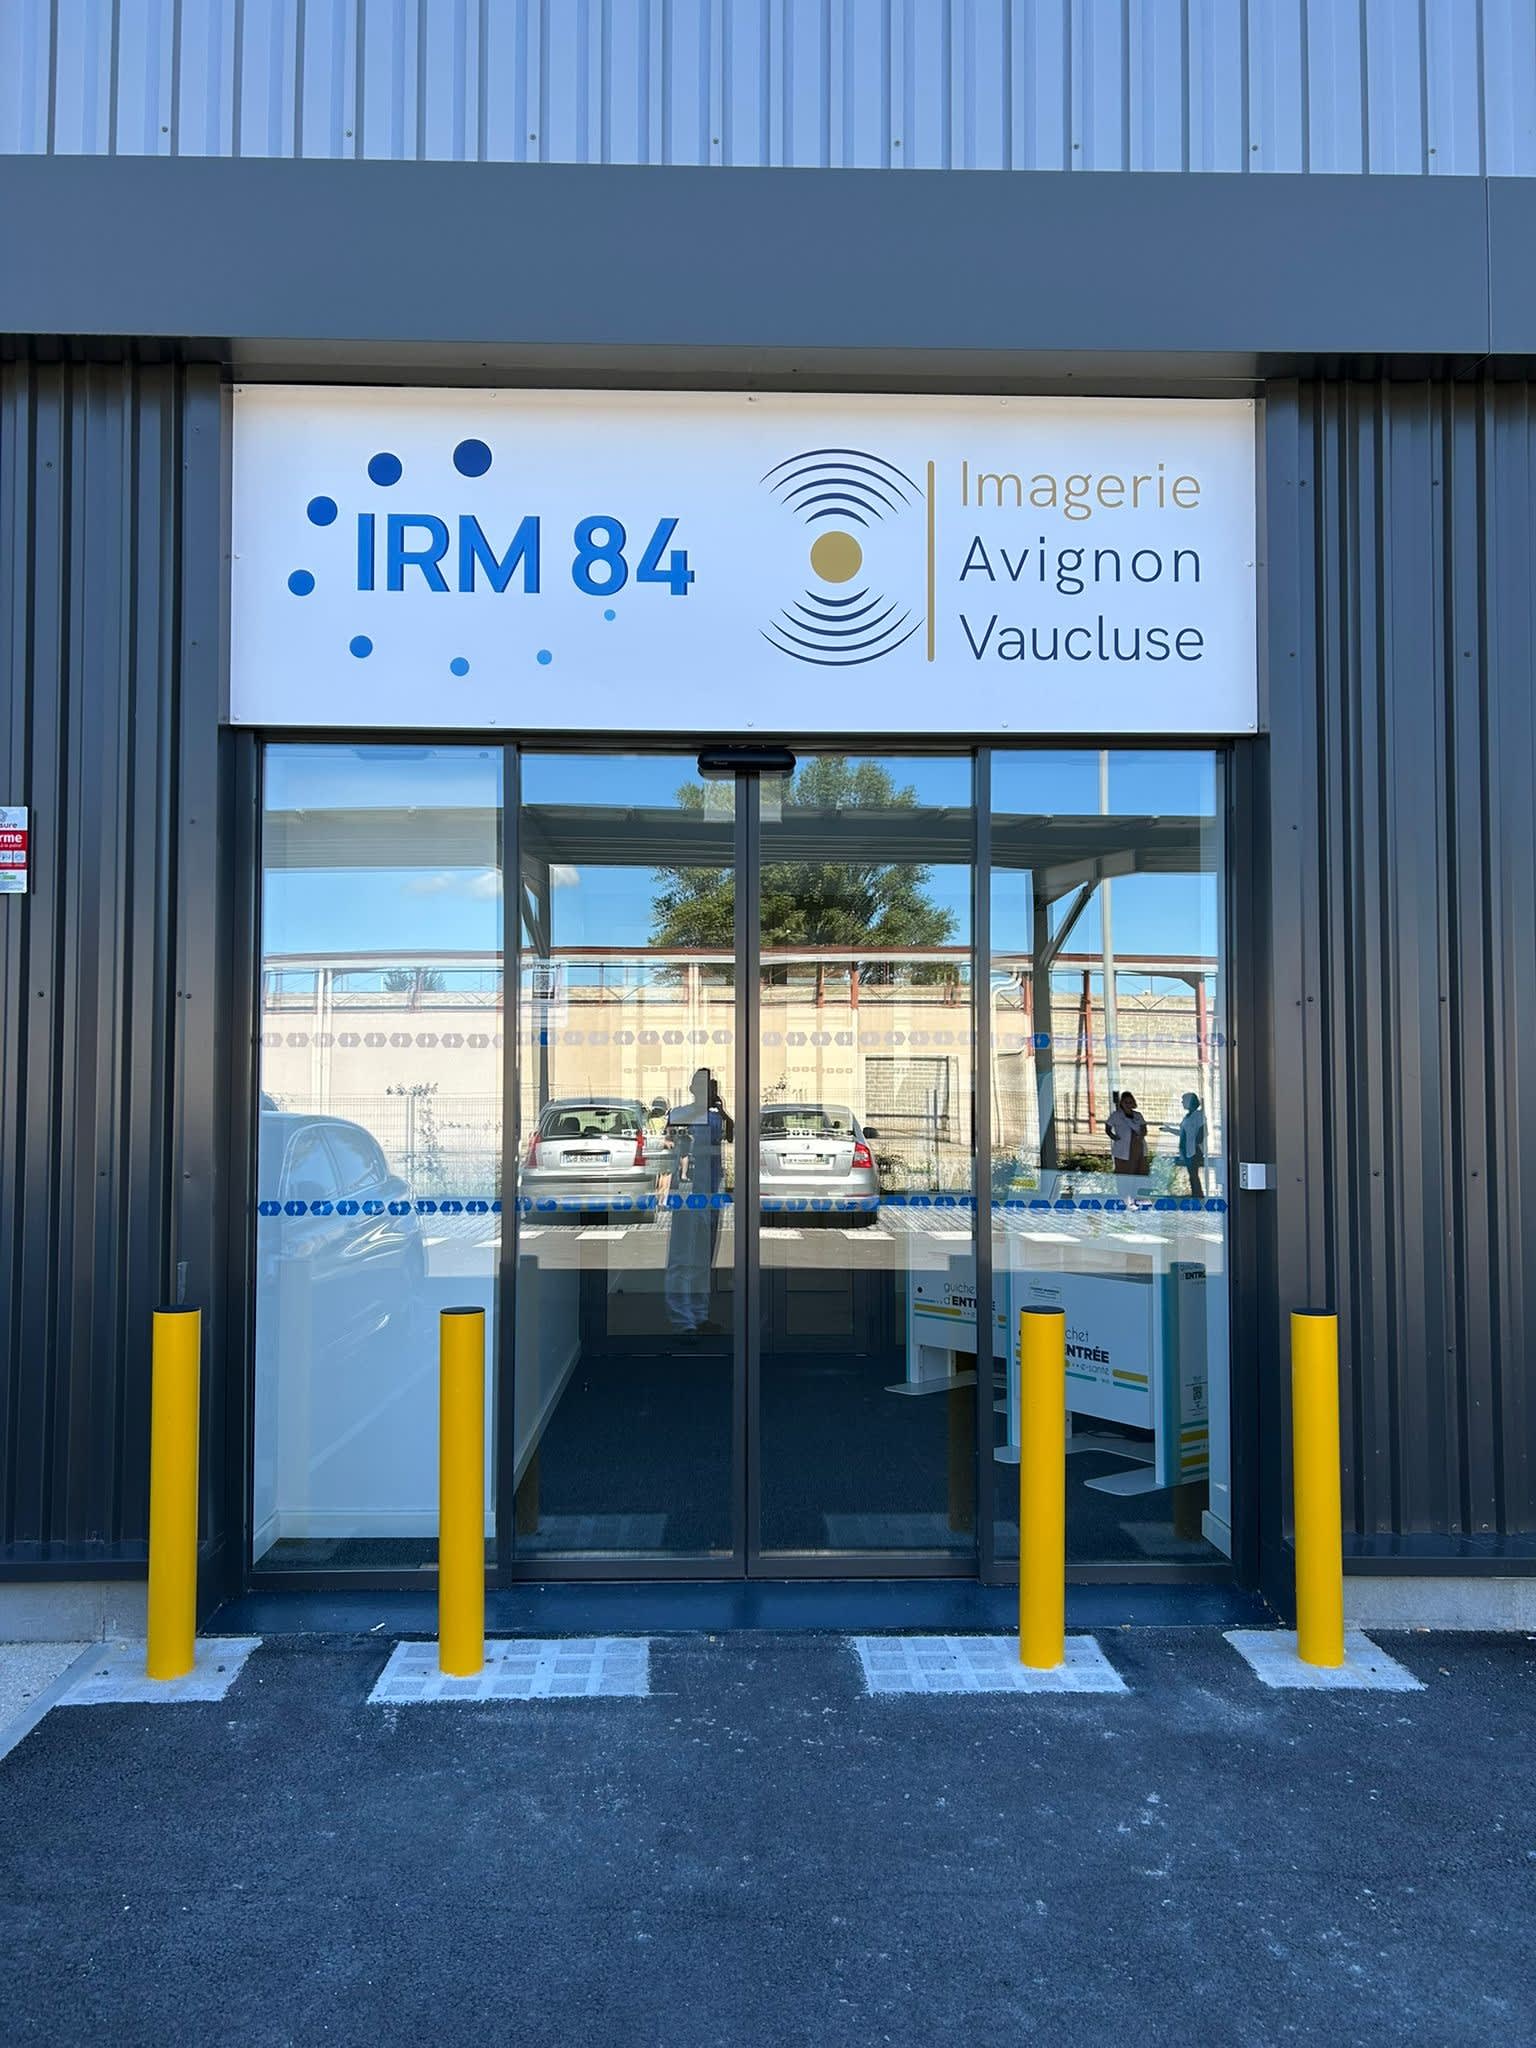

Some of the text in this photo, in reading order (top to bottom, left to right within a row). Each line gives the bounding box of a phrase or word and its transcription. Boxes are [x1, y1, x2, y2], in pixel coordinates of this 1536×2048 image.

[962, 461, 1201, 520] Imagerie
[356, 513, 696, 597] IRM 84
[959, 535, 1201, 595] Avignon
[959, 613, 1205, 662] Vaucluse
[944, 1282, 976, 1295] guiche
[1064, 1326, 1089, 1343] chet
[1065, 1345, 1109, 1364] NTRÉE
